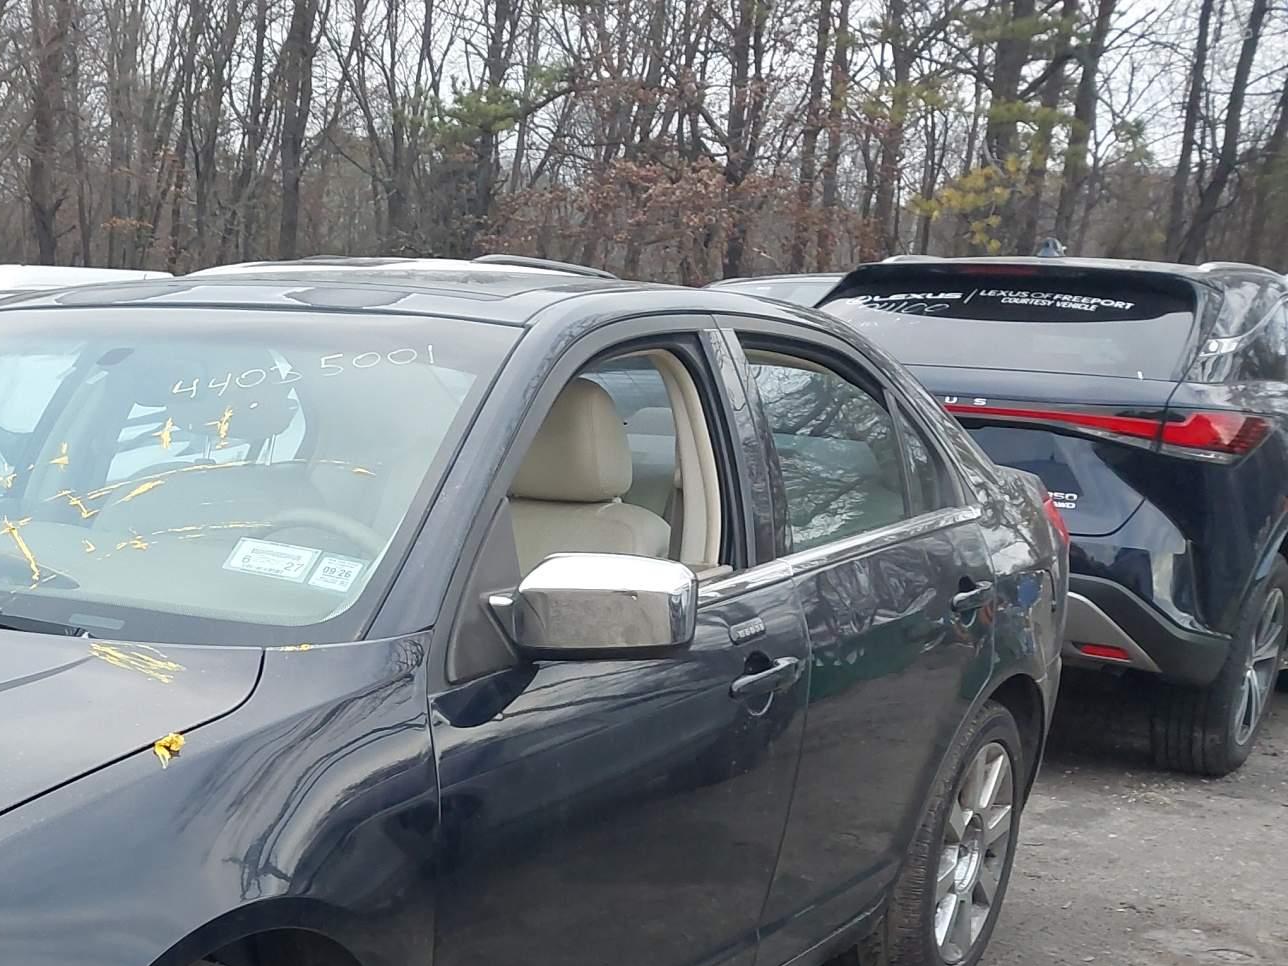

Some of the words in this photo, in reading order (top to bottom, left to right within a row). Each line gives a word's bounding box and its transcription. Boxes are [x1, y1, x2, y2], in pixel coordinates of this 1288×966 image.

[873, 292, 963, 301] LEXUS
[979, 289, 1030, 298] LEXUS
[1031, 291, 1053, 299] OF
[1053, 294, 1135, 310] FREEPORT
[1000, 296, 1054, 307] COURTESY
[1055, 301, 1098, 312] VEHICLE
